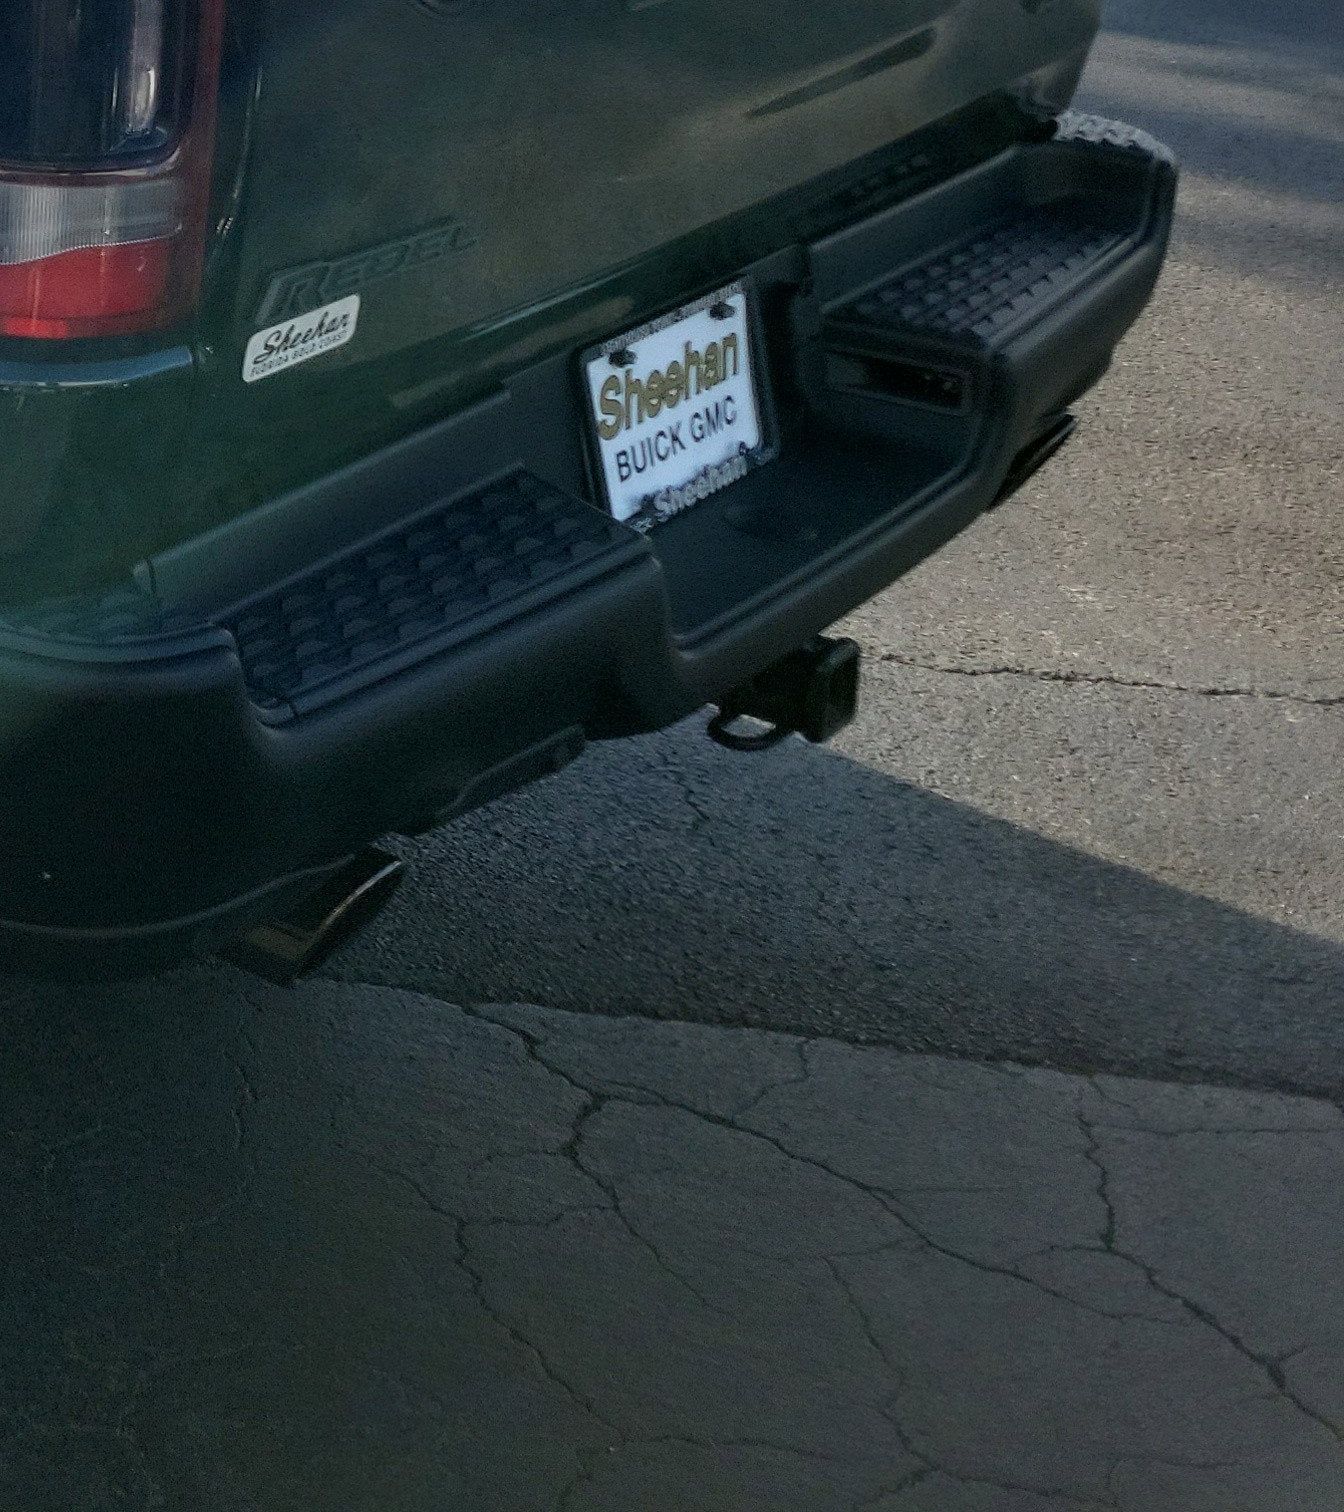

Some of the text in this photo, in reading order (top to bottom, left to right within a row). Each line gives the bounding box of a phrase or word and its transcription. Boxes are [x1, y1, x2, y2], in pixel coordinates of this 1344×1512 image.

[252, 311, 351, 365] Sheehan
[598, 331, 739, 441] Sheehan
[615, 394, 738, 483] BUICK GMC
[653, 452, 749, 523] Sheehan
